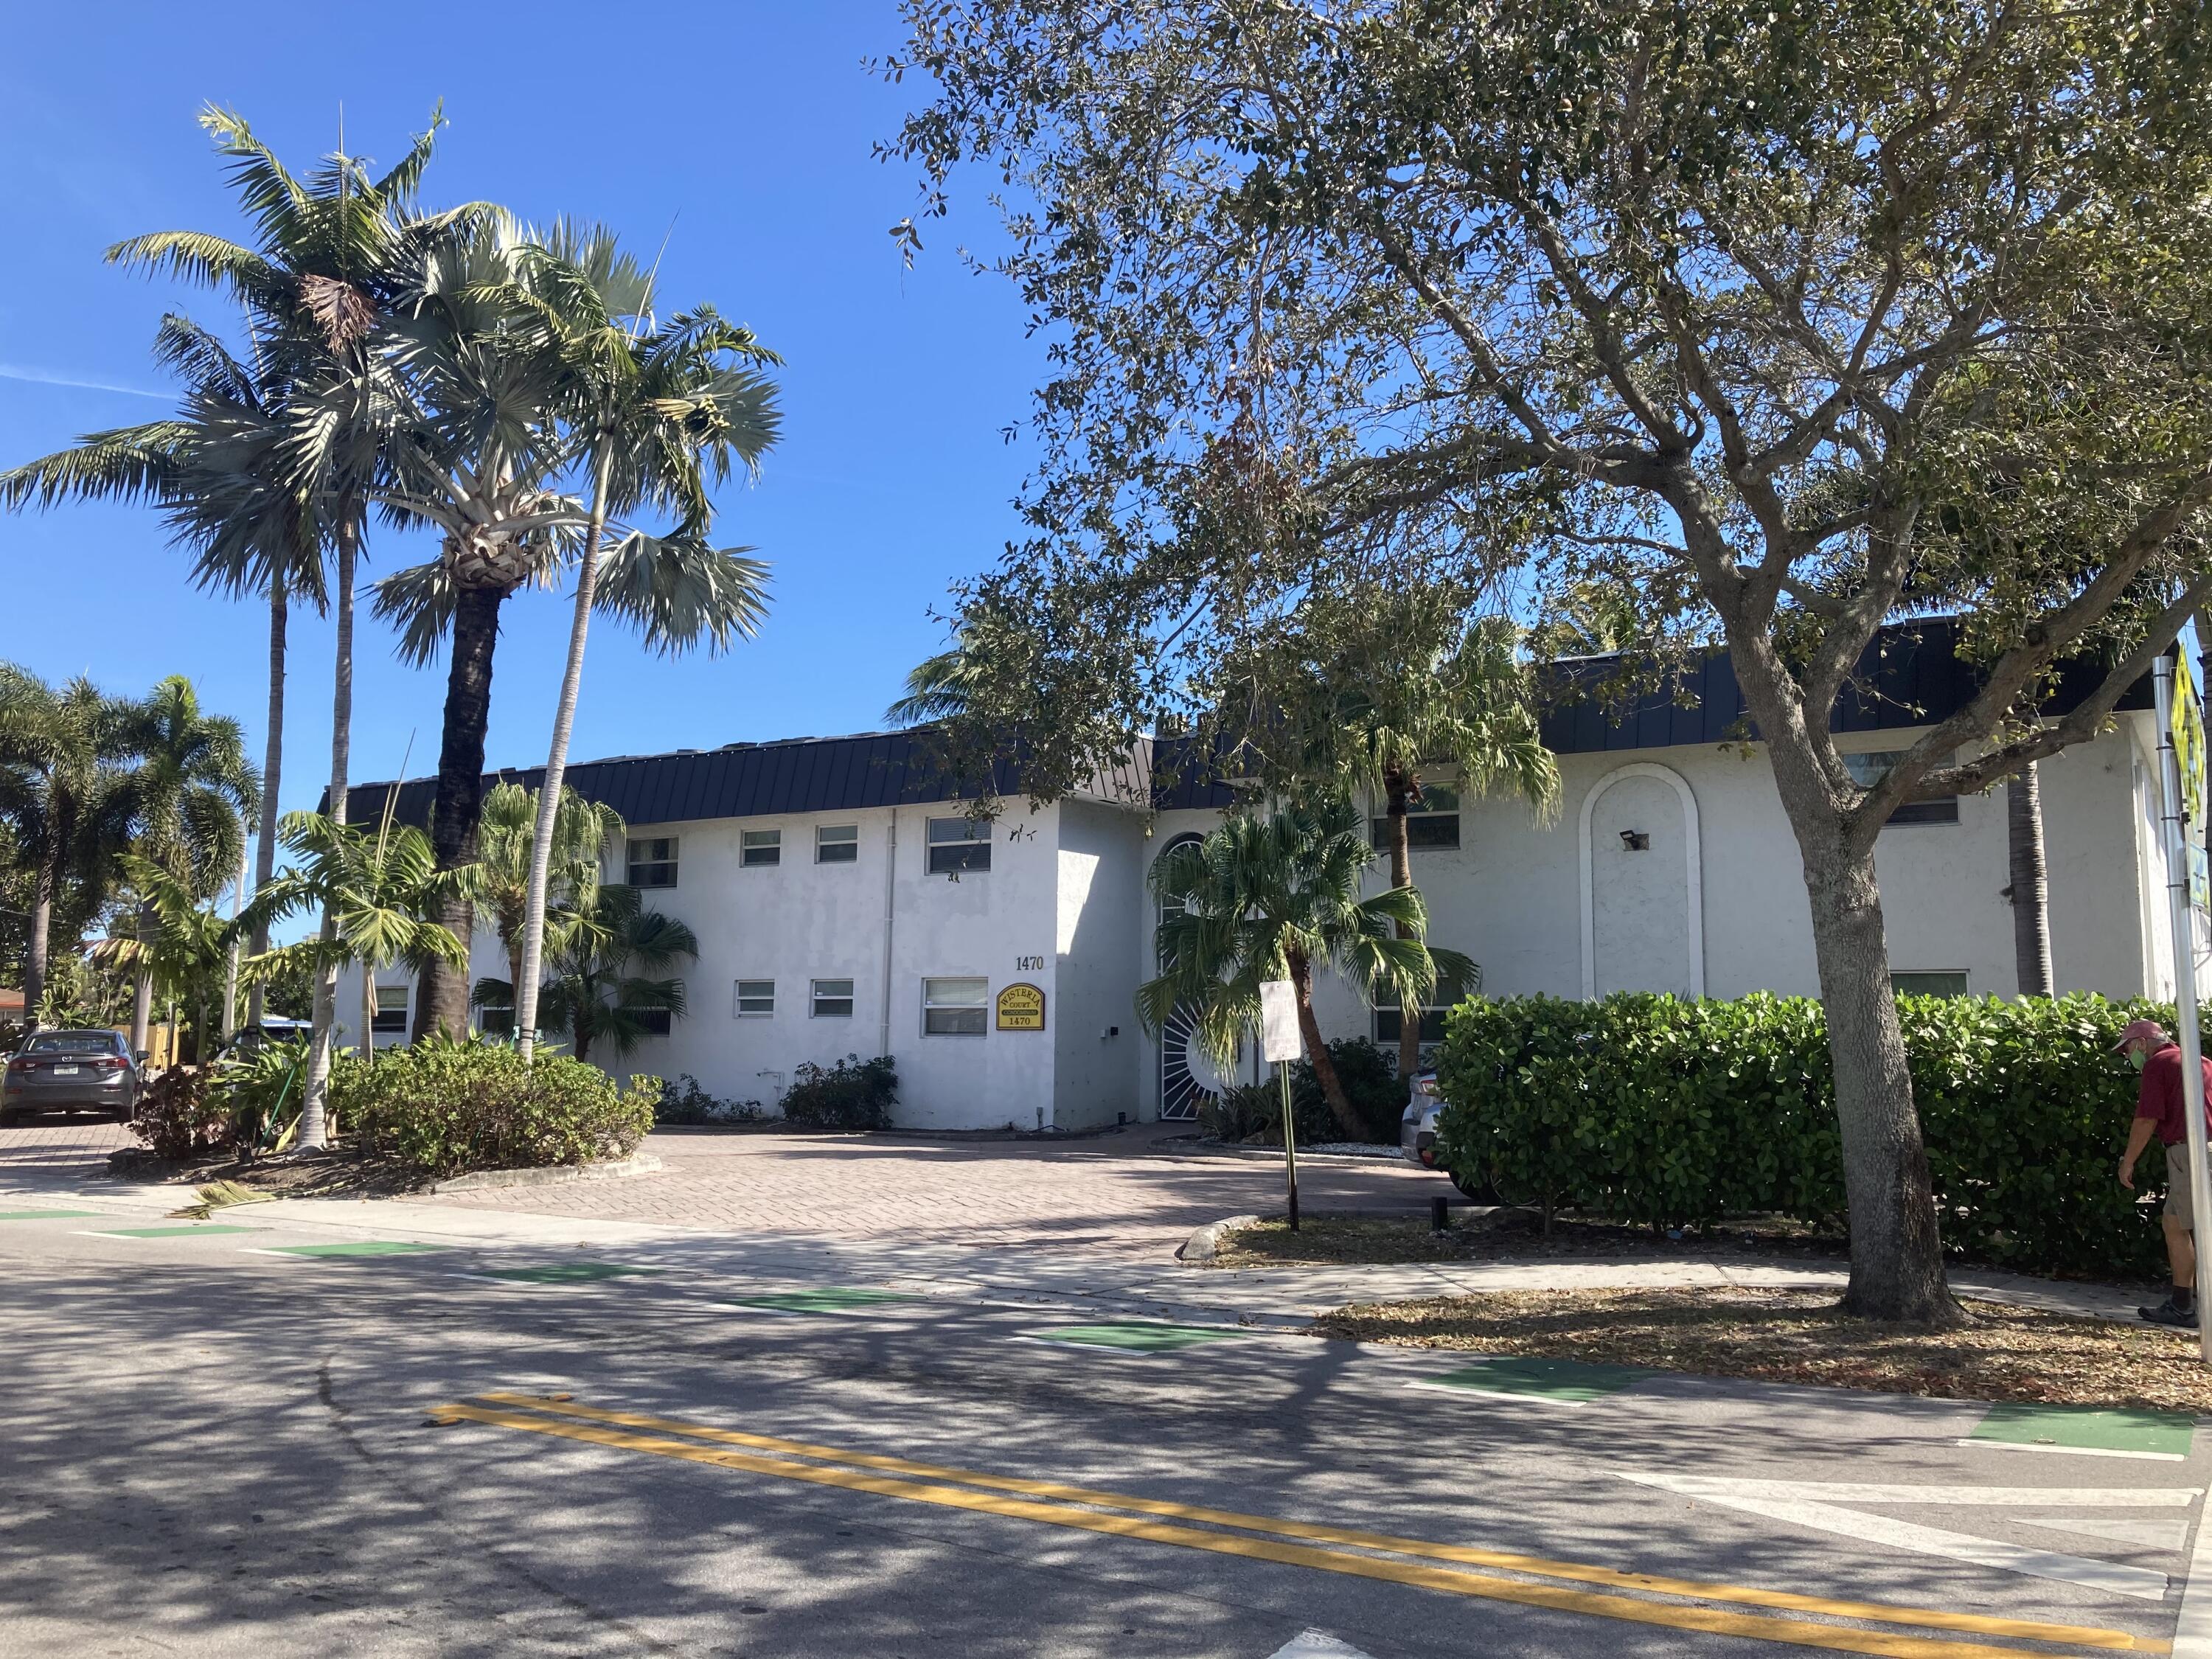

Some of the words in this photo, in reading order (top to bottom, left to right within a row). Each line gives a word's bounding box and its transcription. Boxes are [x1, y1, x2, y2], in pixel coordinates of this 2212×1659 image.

[1016, 956, 1043, 970] 1470
[1000, 988, 1040, 1007] WISTERIA
[1009, 1017, 1031, 1025] 1470
